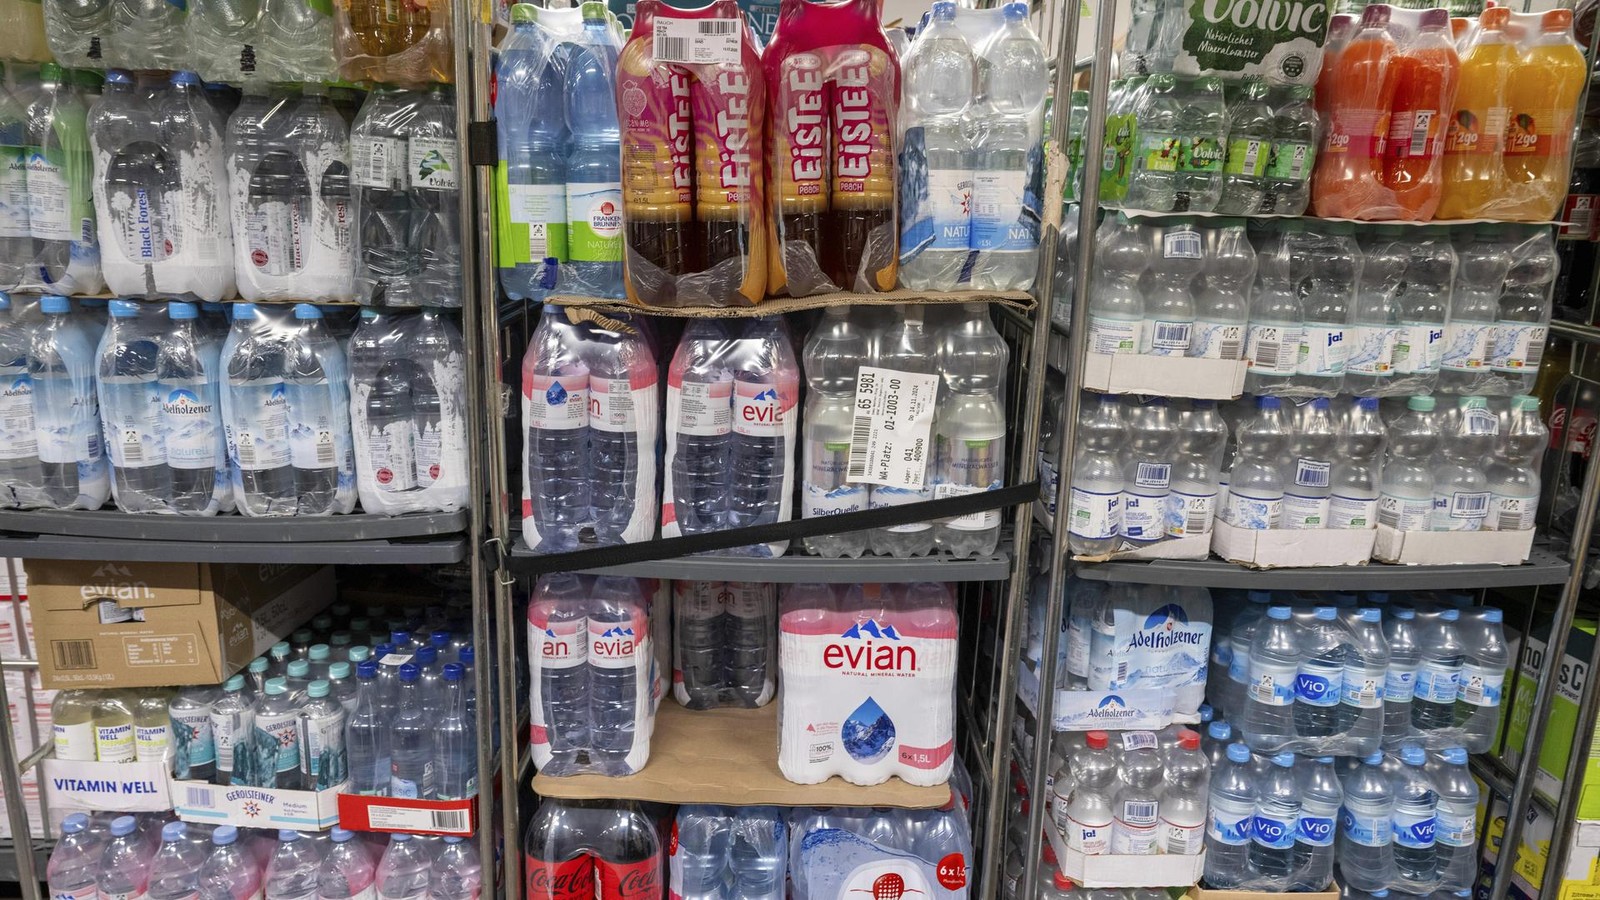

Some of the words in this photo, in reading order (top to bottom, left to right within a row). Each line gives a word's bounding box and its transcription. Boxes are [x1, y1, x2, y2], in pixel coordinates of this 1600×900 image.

[1205, 28, 1254, 46] Natürliches
[139, 226, 152, 257] Black
[1327, 332, 1343, 346] ja!
[1429, 330, 1443, 344] ja!
[860, 373, 875, 394] 5981
[858, 399, 871, 409] 65
[884, 379, 901, 430] 01-1003-00
[879, 441, 893, 480] WA-Platz:
[903, 448, 914, 462] 041
[1107, 497, 1119, 512] ja!
[1126, 498, 1139, 510] ja!
[1126, 630, 1204, 653] Adelholzener
[1087, 708, 1135, 718] Adelholzener
[99, 725, 131, 735] VITAMIN
[54, 779, 117, 793] VITAMIN
[122, 782, 157, 794] WELL
[226, 790, 275, 804] GEROLSTEINER
[1304, 819, 1329, 833] ViO
[1083, 829, 1096, 840] ja!
